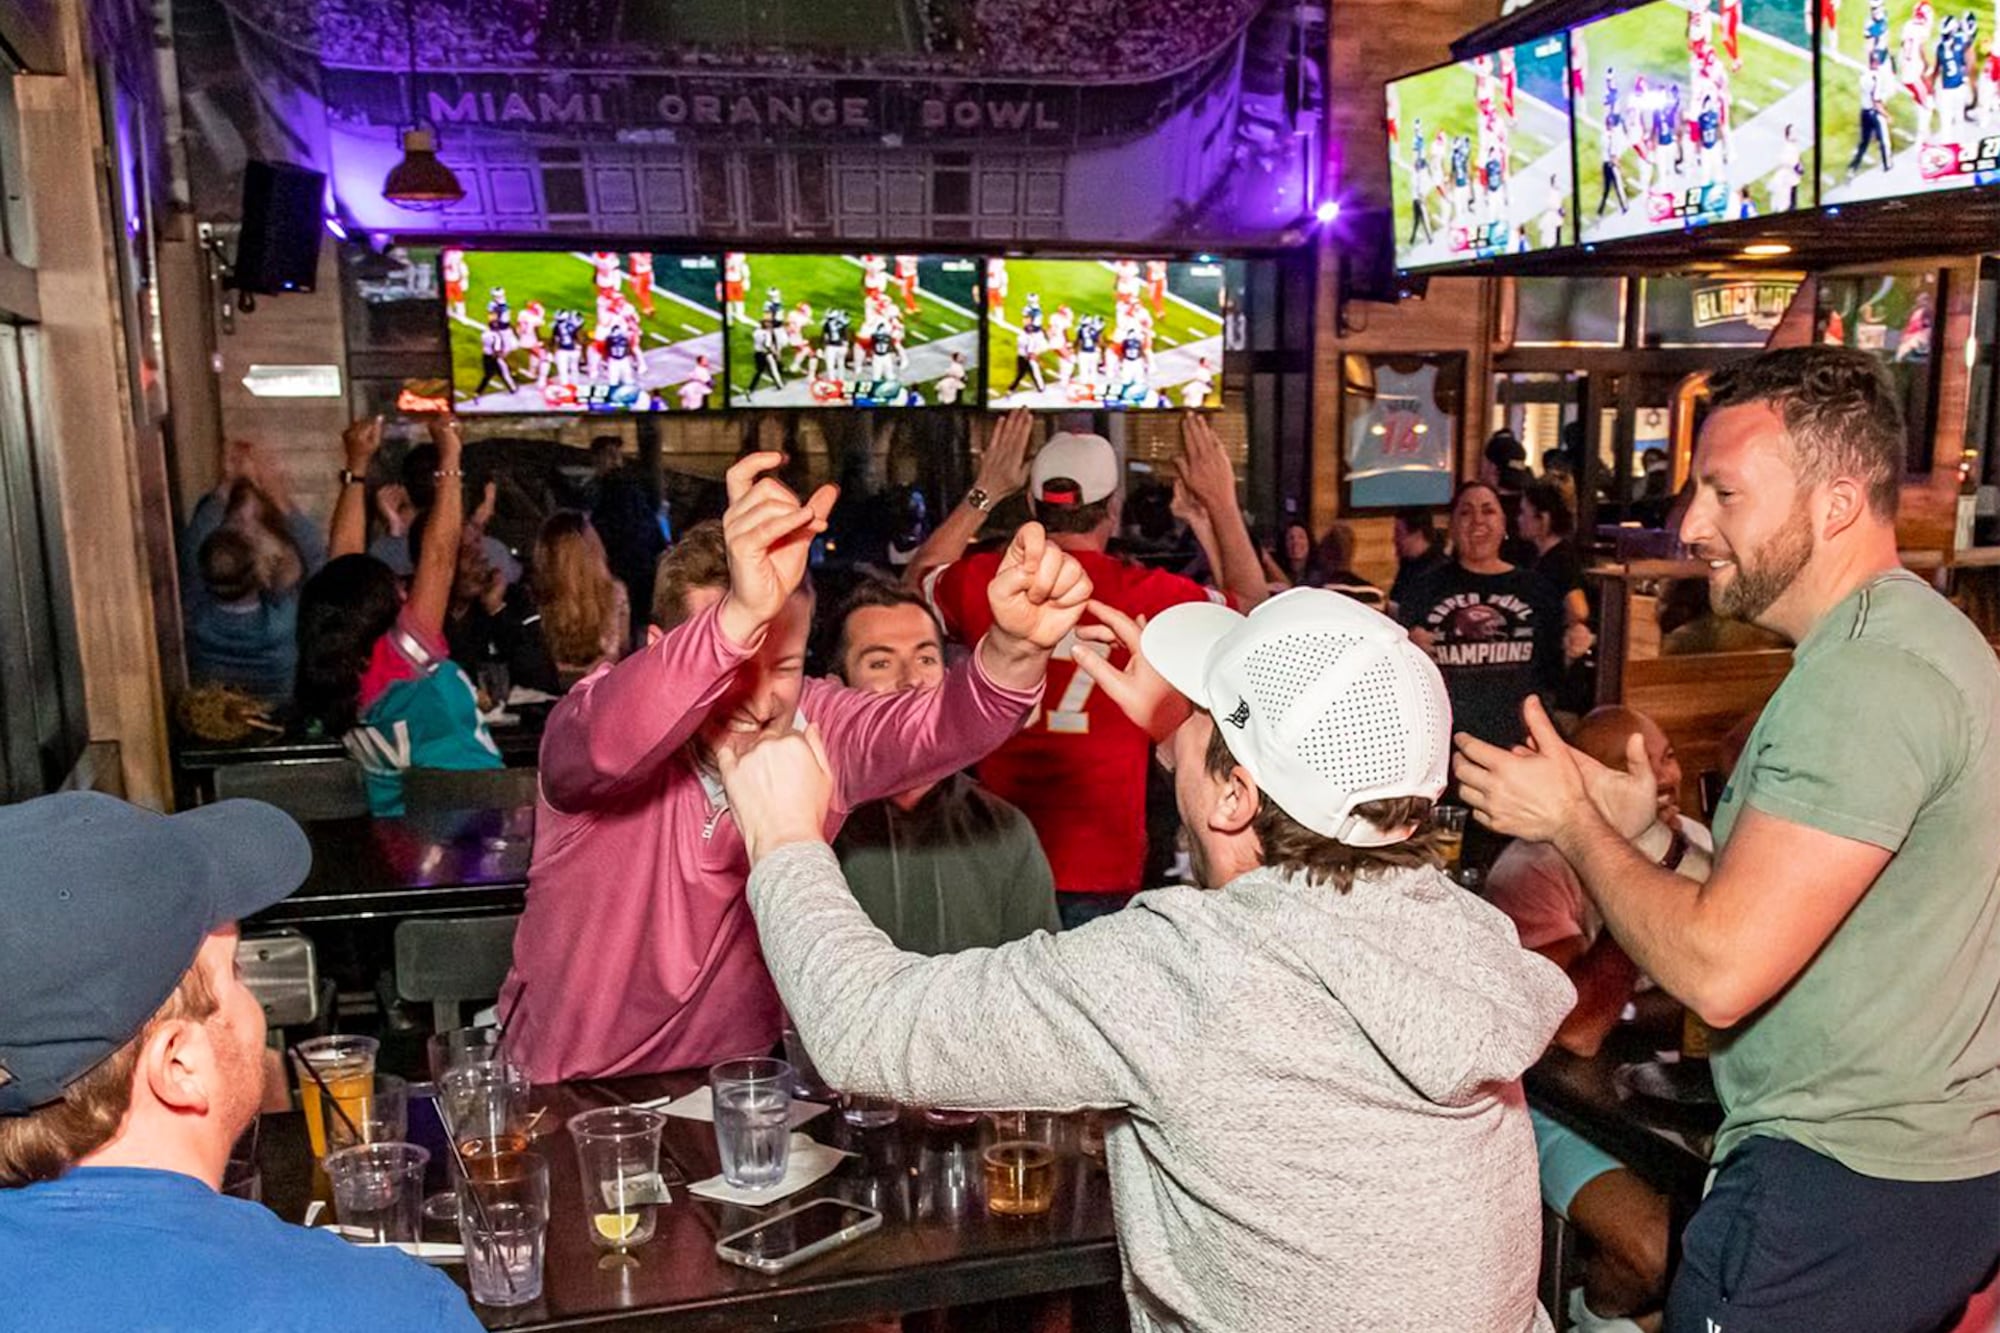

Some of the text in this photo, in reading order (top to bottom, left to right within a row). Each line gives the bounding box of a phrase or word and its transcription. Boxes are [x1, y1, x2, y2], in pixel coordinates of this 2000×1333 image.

[427, 91, 1060, 130] MIAMI ORANGE BOWL
[1427, 592, 1481, 625] SUPER
[1432, 641, 1534, 665] HAMPIONS
